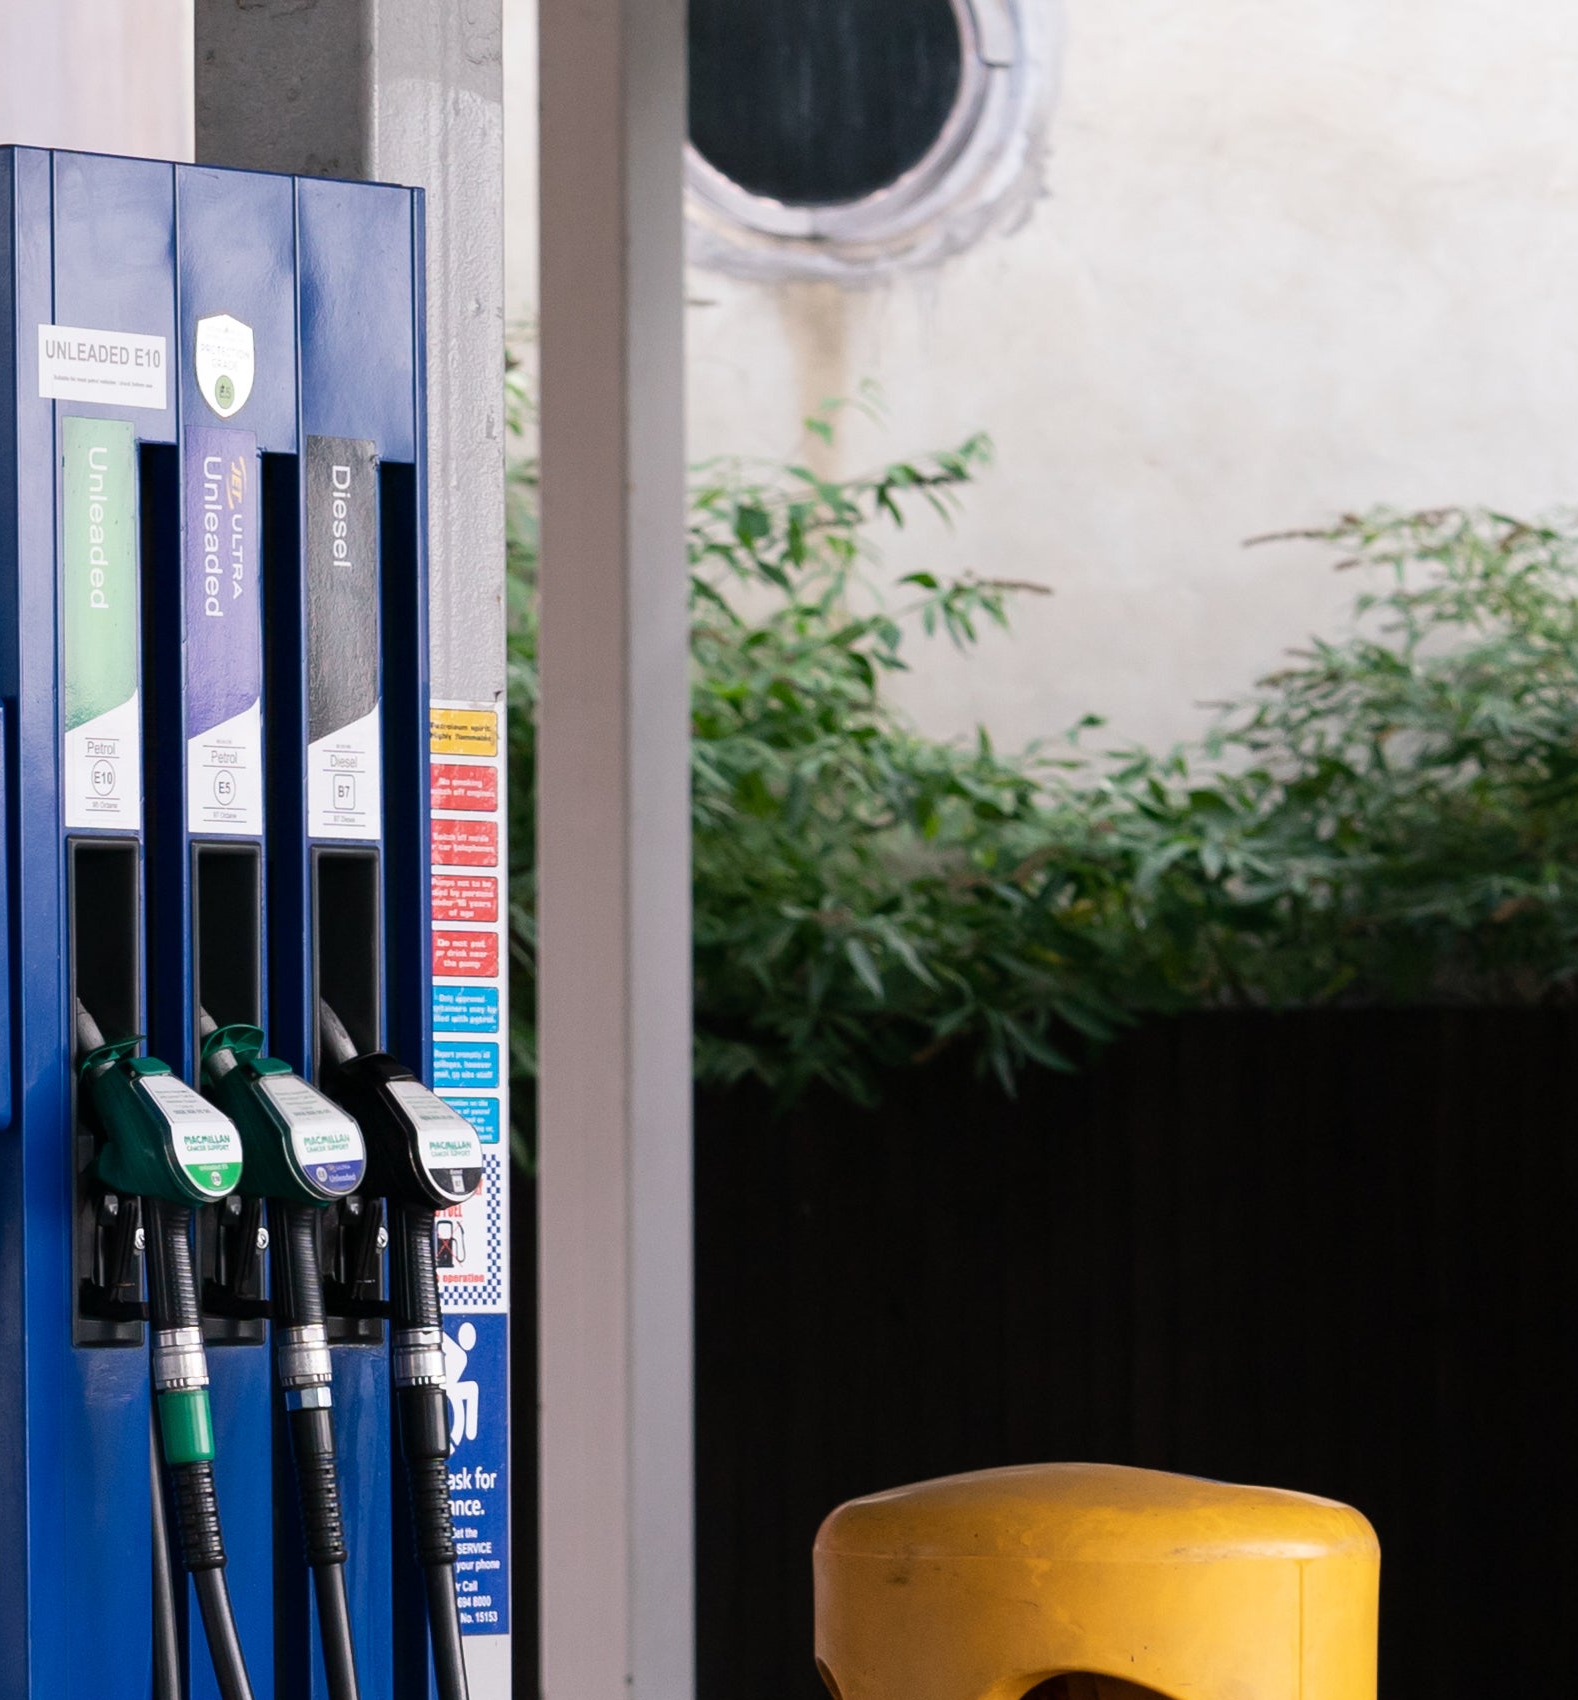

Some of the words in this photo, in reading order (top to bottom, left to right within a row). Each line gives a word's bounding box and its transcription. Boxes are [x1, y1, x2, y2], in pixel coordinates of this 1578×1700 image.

[45, 340, 130, 365] UNLEADED
[135, 349, 161, 367] E10
[228, 459, 245, 506] JET
[332, 465, 351, 567] Diesel
[89, 448, 108, 609] Unleaded
[204, 457, 223, 616] Unleaded
[232, 514, 243, 599] ULTRA
[87, 741, 116, 755] Petrol
[211, 750, 238, 764] Petrol
[330, 754, 358, 768] Diesel
[94, 771, 112, 784] E10
[219, 782, 230, 794] E5
[338, 785, 349, 798] B7
[437, 938, 450, 947] Do
[452, 940, 468, 948] not
[444, 959, 456, 967] the
[459, 960, 481, 969] pump
[184, 1135, 230, 1145] MACMILLAN
[304, 1134, 349, 1146] MACMILLAN
[443, 1273, 484, 1283] operation
[447, 1467, 472, 1490] ask
[474, 1466, 497, 1489] for
[465, 1528, 478, 1539] the
[456, 1542, 492, 1554] SERVICE
[456, 1560, 474, 1573] your
[475, 1559, 500, 1571] phone
[462, 1581, 478, 1592] Call
[460, 1612, 473, 1623] No.
[475, 1611, 498, 1622] 15153
